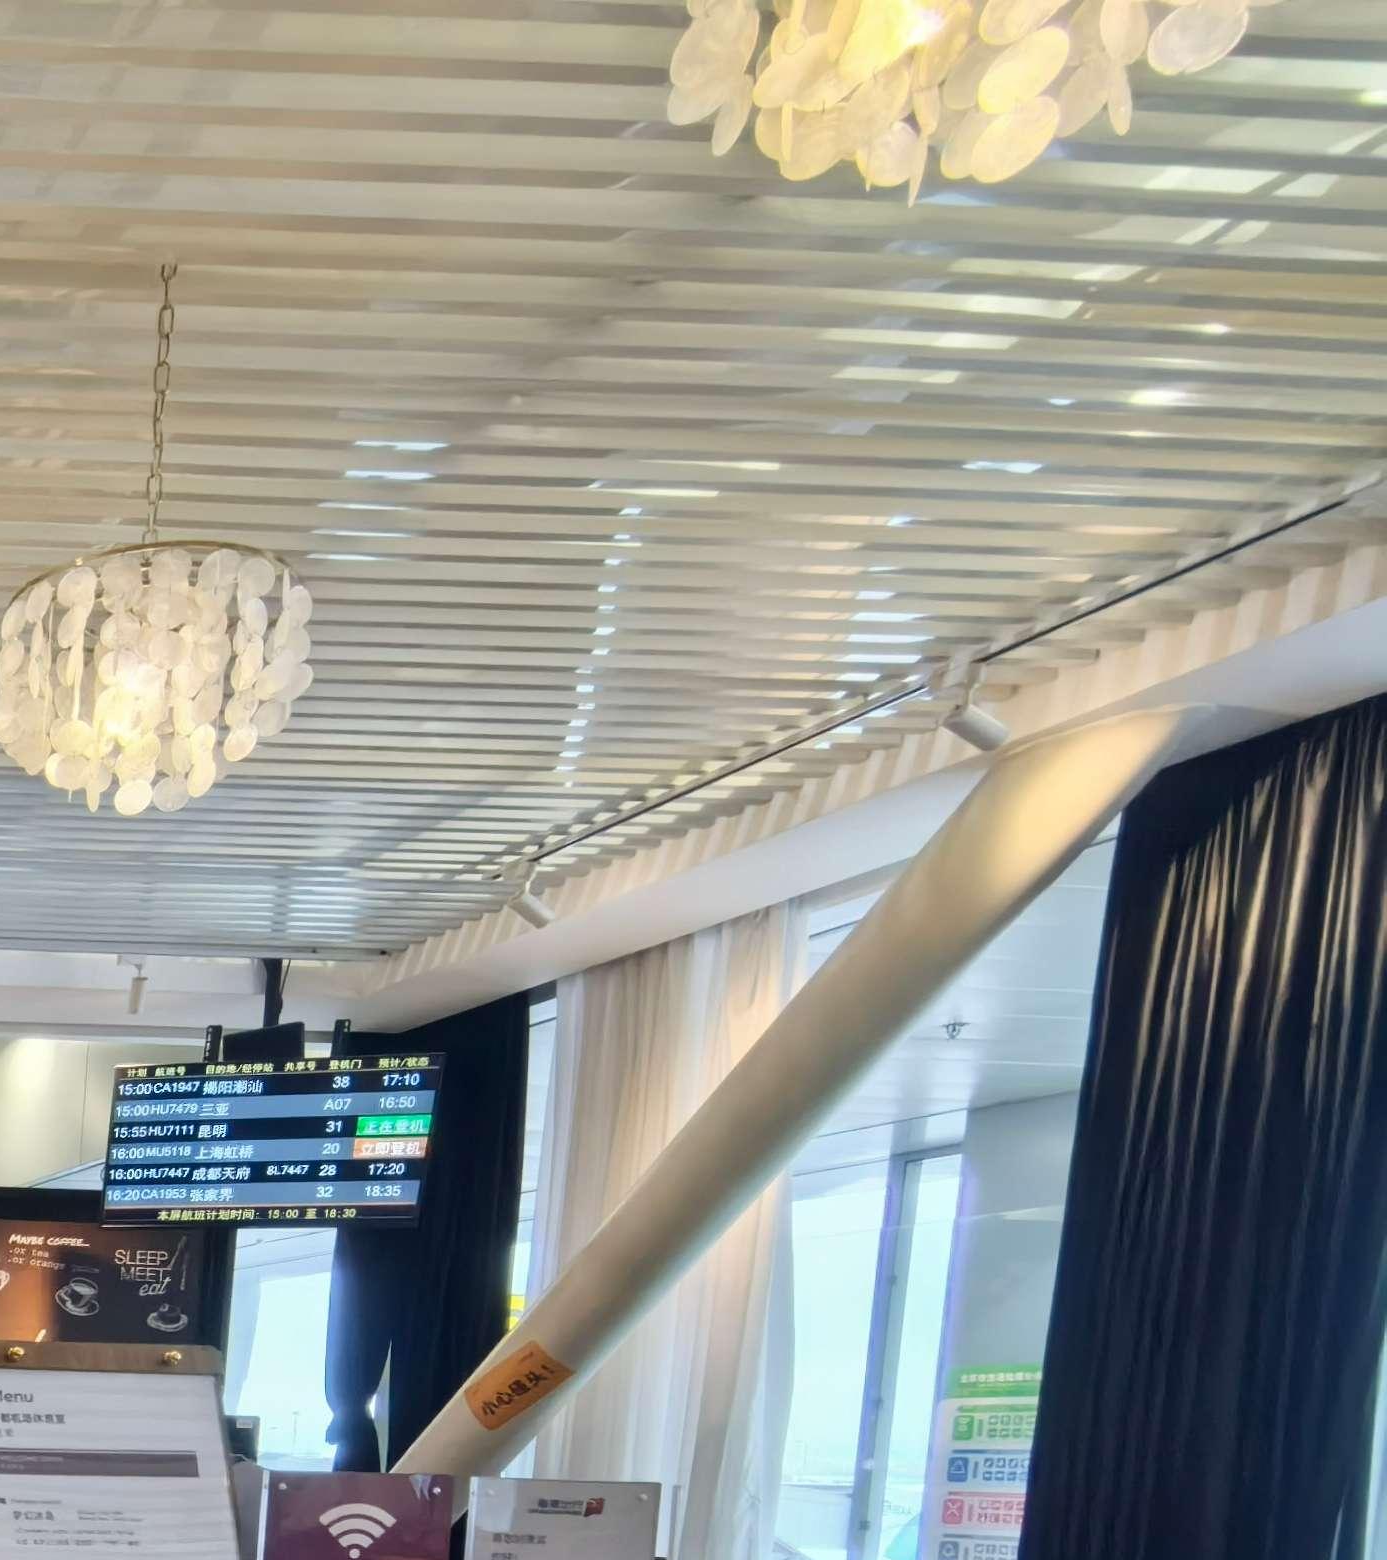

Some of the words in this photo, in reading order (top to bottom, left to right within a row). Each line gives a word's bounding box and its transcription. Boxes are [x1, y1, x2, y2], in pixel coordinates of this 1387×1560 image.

[118, 1083, 152, 1096] 15:00
[153, 1081, 201, 1094] CA1947
[332, 1075, 351, 1089] 38
[382, 1073, 420, 1087] 17:10
[116, 1105, 150, 1118] 15:00
[198, 1102, 230, 1117] 三亚
[323, 1097, 352, 1111] A07
[379, 1095, 416, 1109] 16:50
[113, 1126, 147, 1139] 15:55
[148, 1124, 195, 1138] HU7111
[197, 1123, 228, 1138] 昆明
[325, 1120, 343, 1133] 31
[112, 1147, 145, 1160] 16:00
[194, 1144, 255, 1160] 上海虹桥
[321, 1142, 341, 1155] 20
[109, 1168, 142, 1180] 16:00
[143, 1167, 190, 1179] HU7447
[191, 1166, 251, 1181] 成都天府
[266, 1164, 310, 1176] 8L7447
[318, 1164, 337, 1176] 28
[368, 1162, 405, 1175] 17:20
[107, 1190, 140, 1202] 16:20
[140, 1188, 187, 1200] CA1953
[189, 1187, 235, 1202] 张家界
[315, 1186, 334, 1198] 32
[364, 1185, 402, 1197] 18:35
[114, 1249, 169, 1266] SLEEP
[120, 1266, 168, 1282] MEET
[139, 1276, 172, 1297] eat
